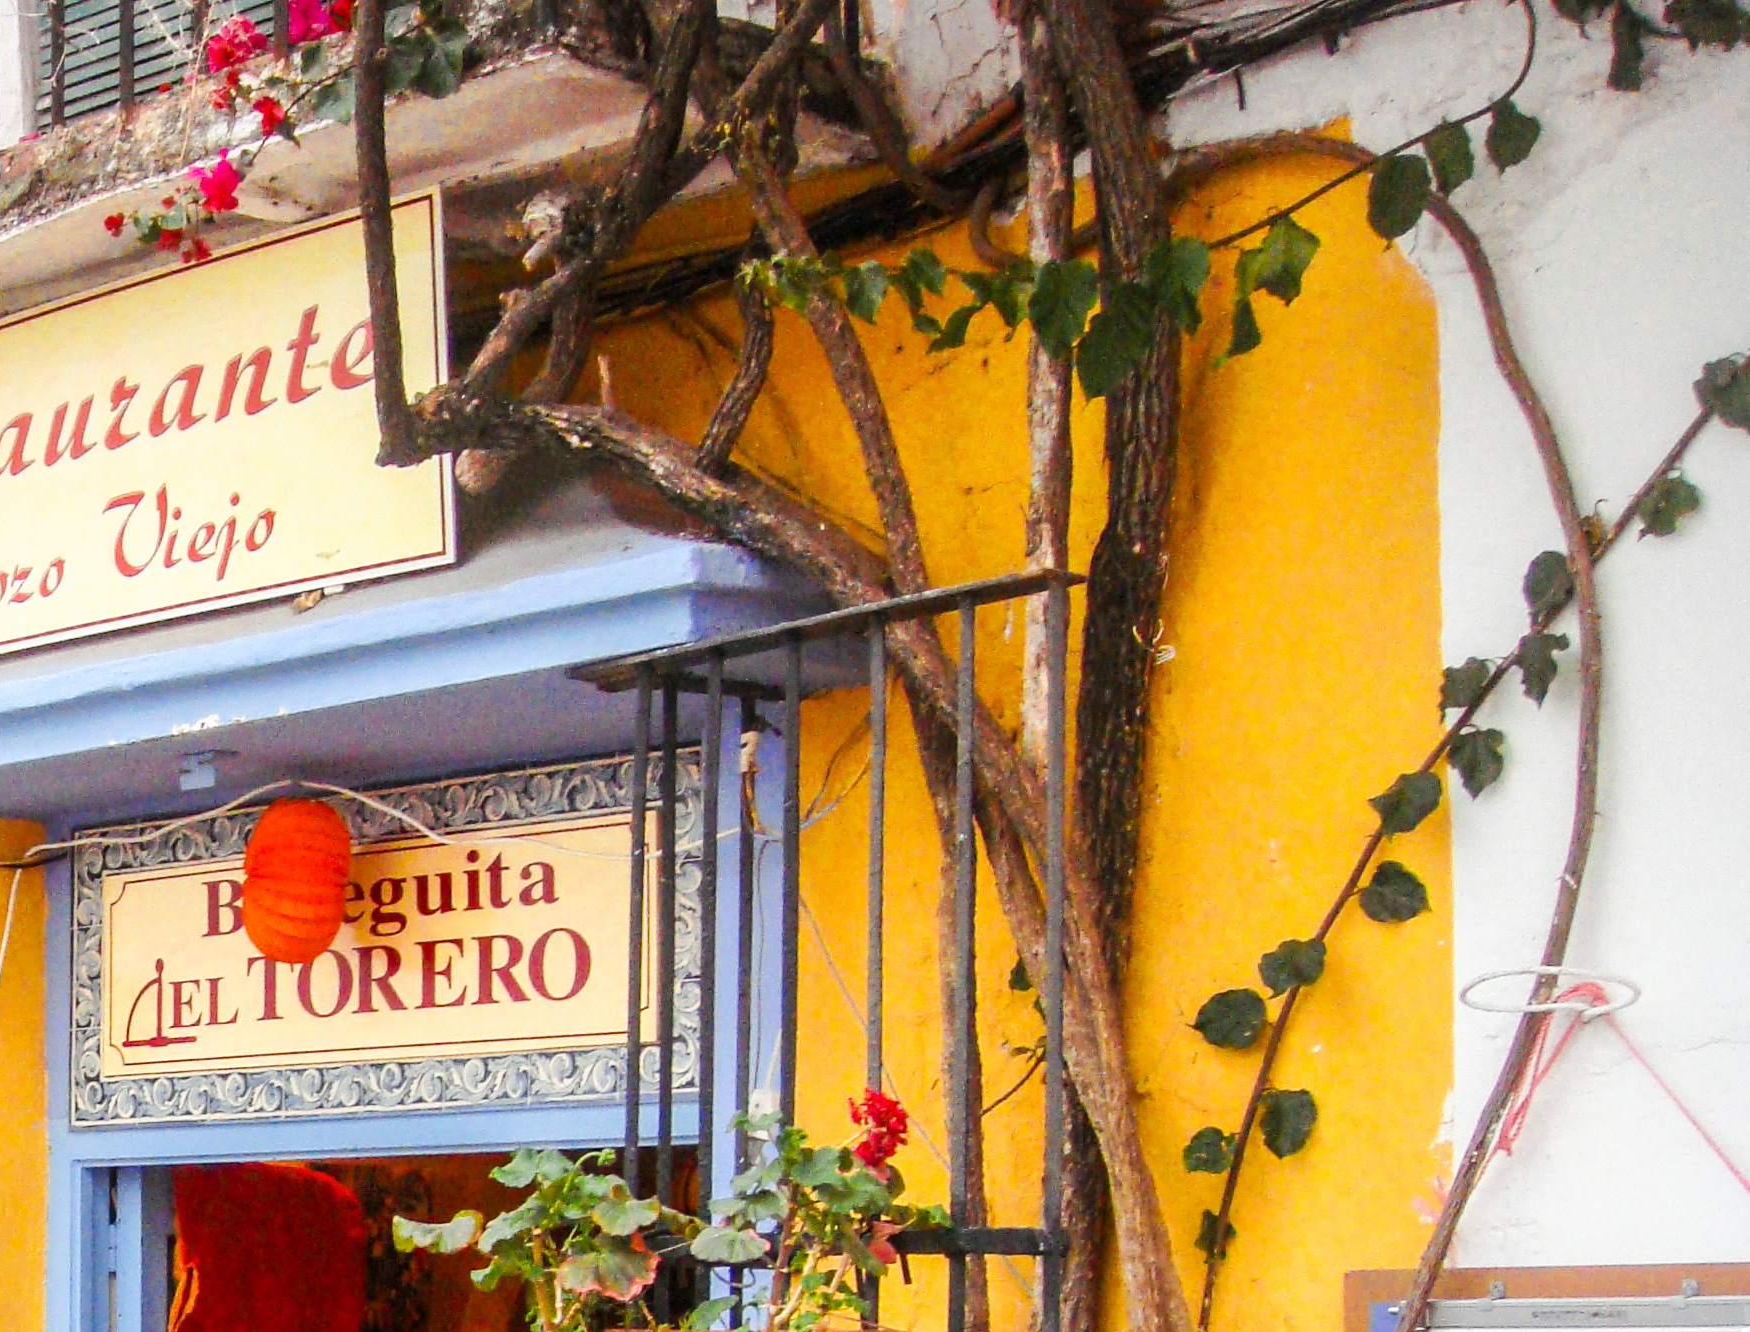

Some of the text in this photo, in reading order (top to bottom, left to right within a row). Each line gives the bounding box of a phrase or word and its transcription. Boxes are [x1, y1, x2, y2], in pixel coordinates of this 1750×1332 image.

[103, 483, 277, 581] Viejo
[201, 849, 559, 938] Beguita
[168, 927, 592, 1029] EL TORERO
